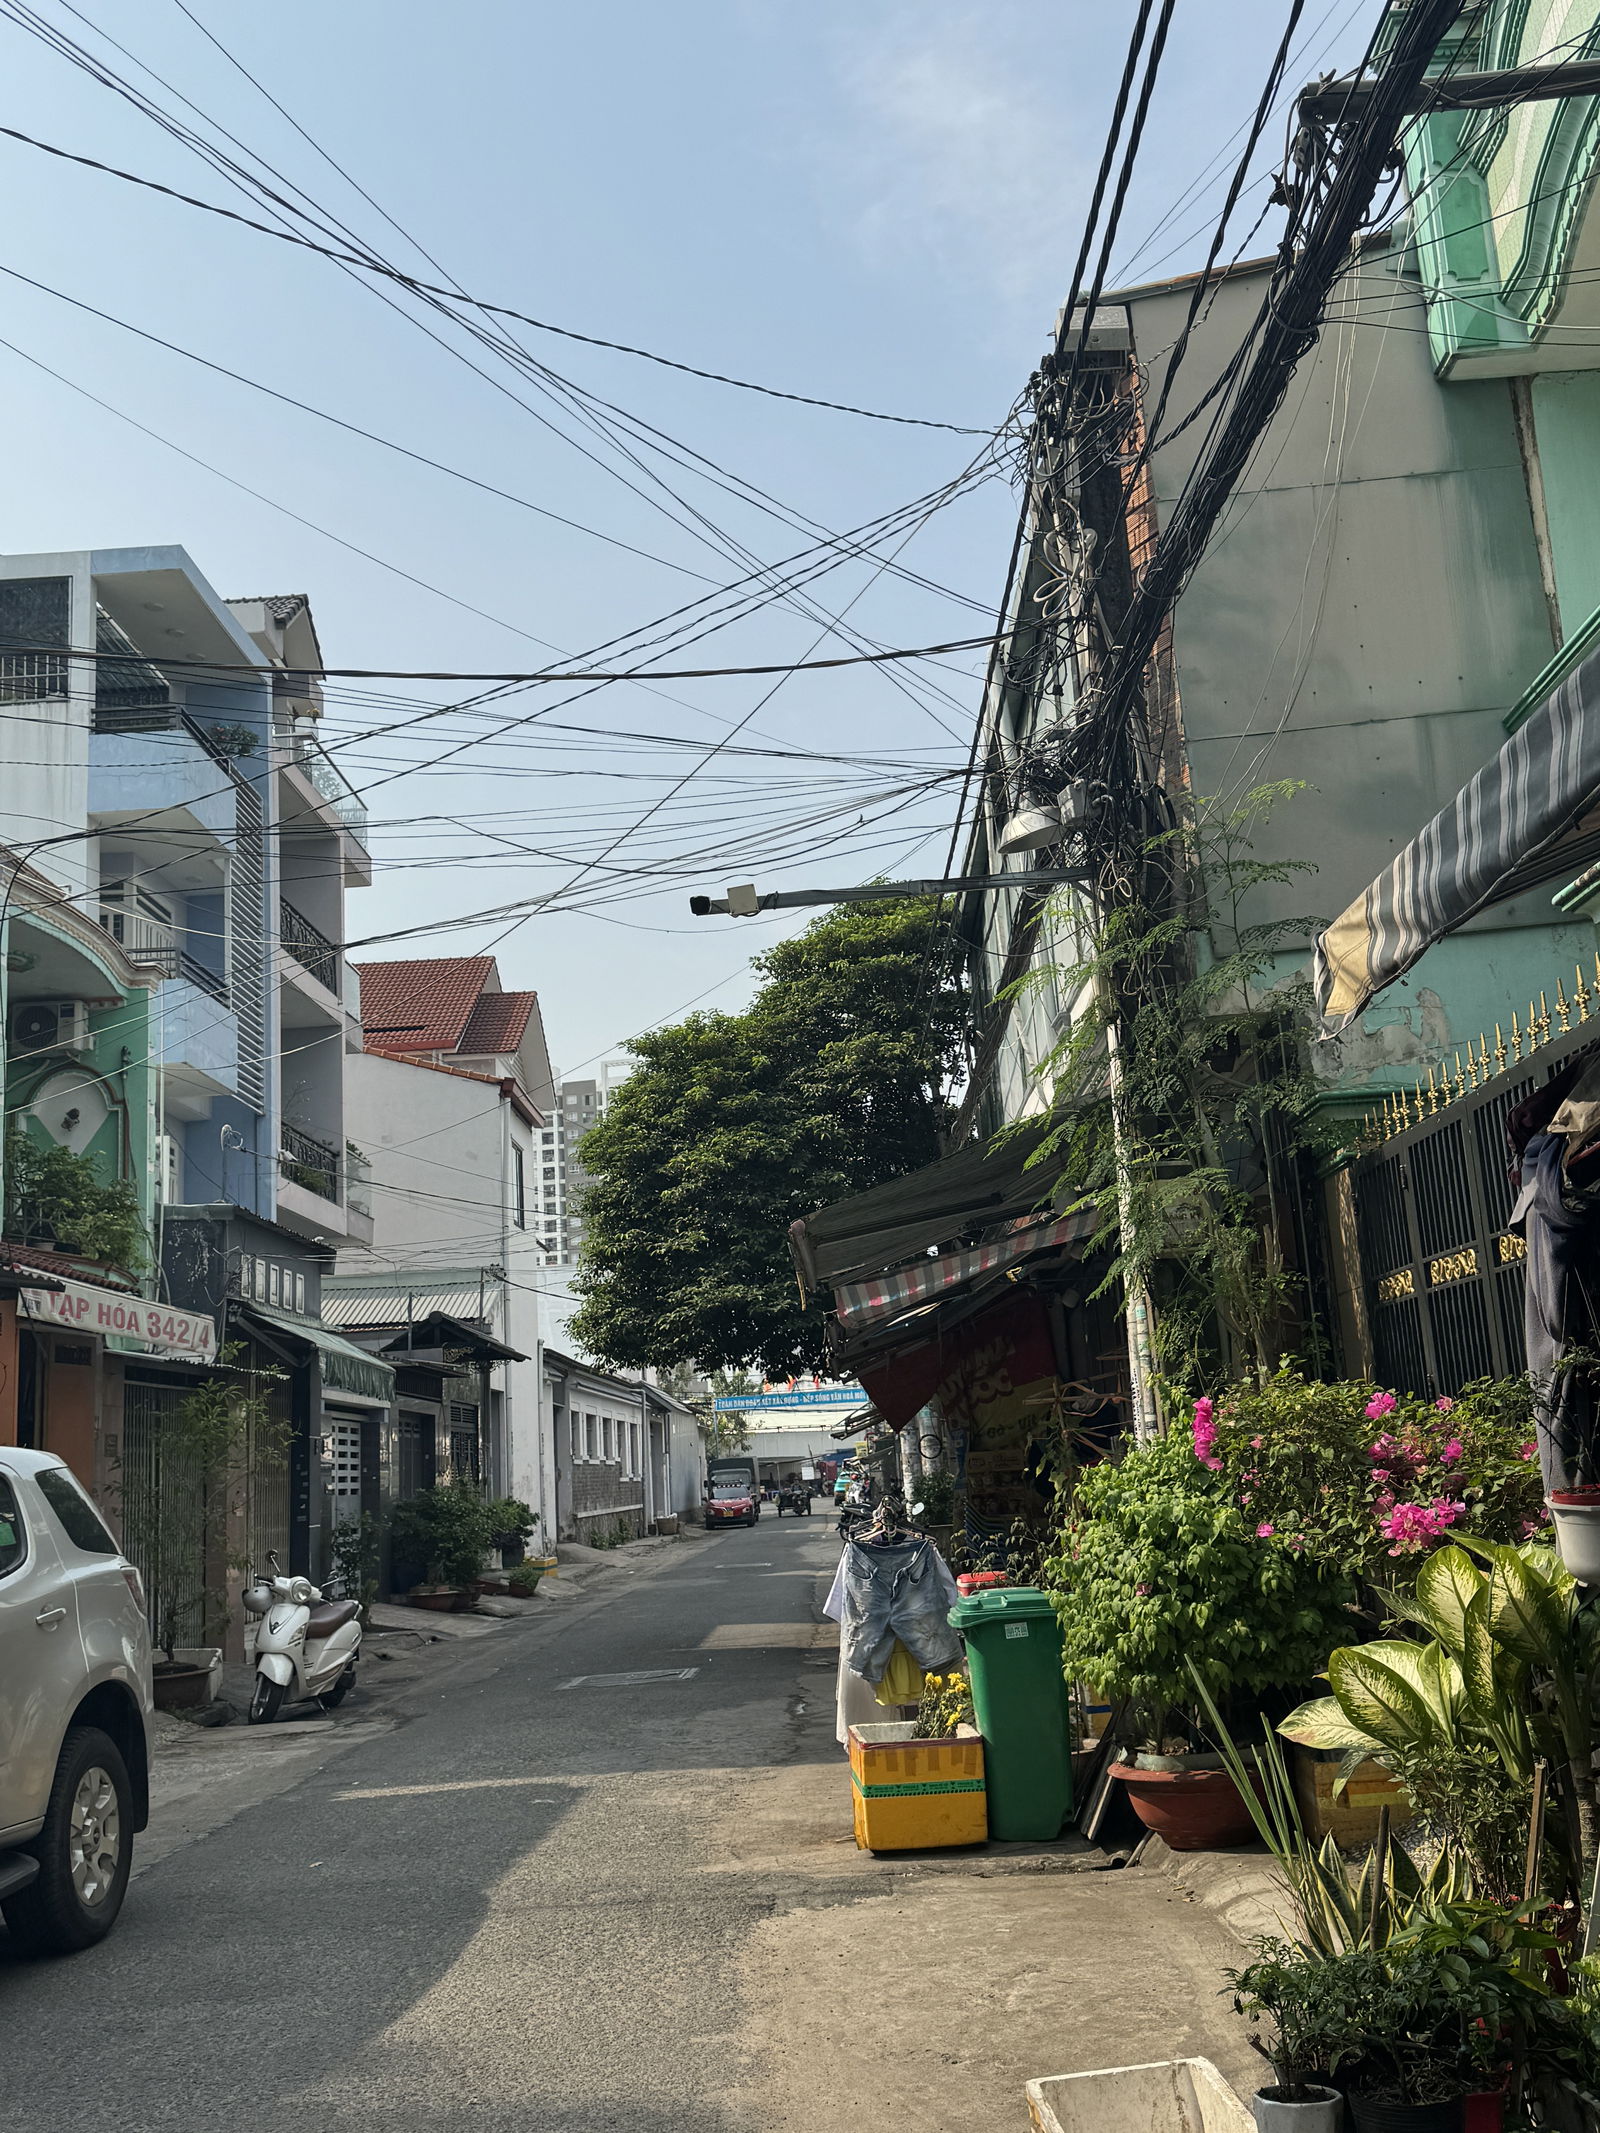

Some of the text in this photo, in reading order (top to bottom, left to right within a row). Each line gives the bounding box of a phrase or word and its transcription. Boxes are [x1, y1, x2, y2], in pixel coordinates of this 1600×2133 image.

[47, 1290, 90, 1322] TẠP
[98, 1302, 140, 1333] HÓA
[147, 1311, 210, 1349] 342/4
